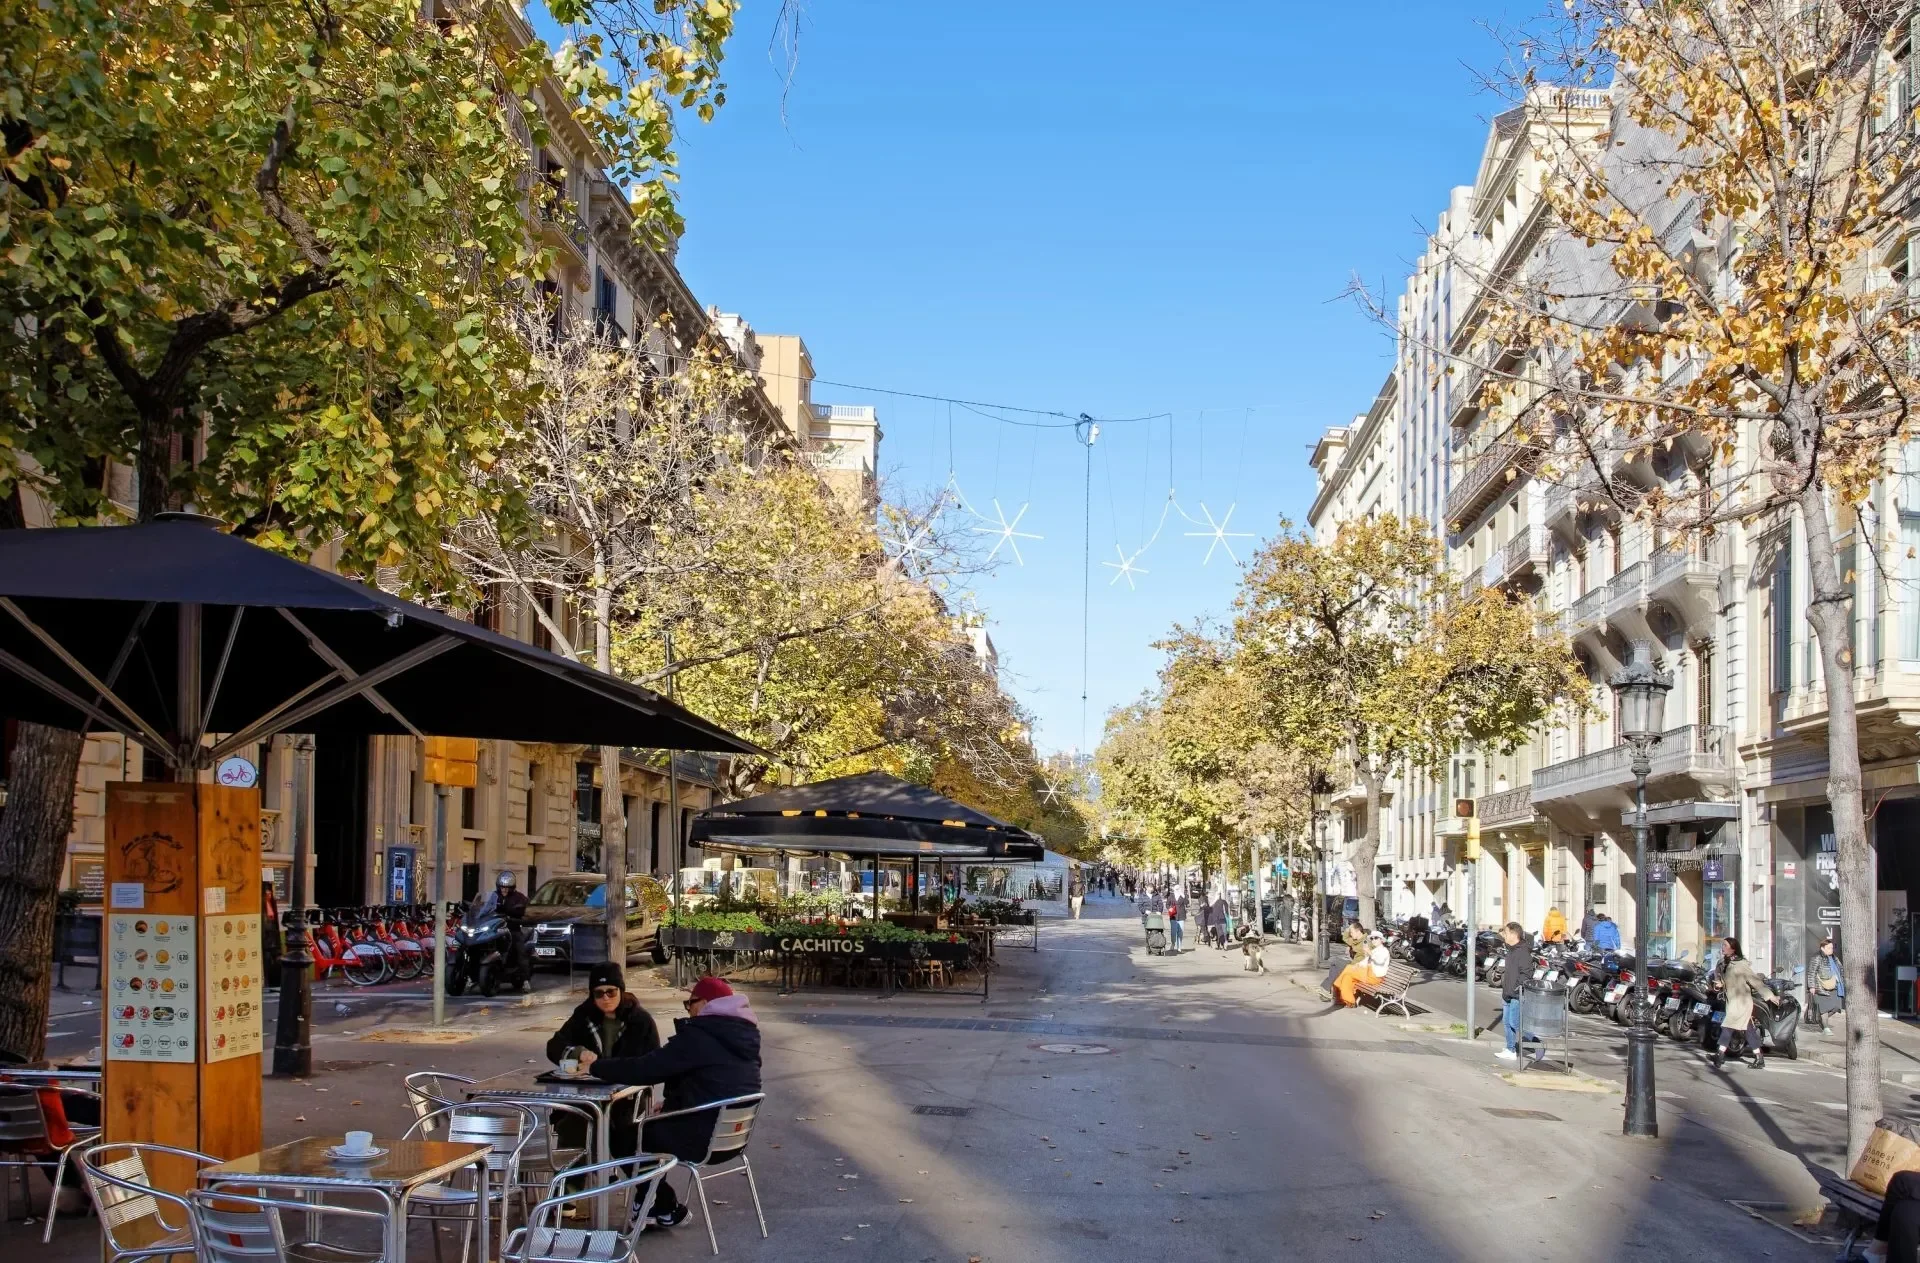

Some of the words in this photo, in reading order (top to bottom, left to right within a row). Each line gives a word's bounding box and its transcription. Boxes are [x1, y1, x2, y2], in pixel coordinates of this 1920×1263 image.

[780, 938, 865, 953] CACHITOS
[1867, 1145, 1895, 1162] honest
[1863, 1154, 1890, 1170] greens
